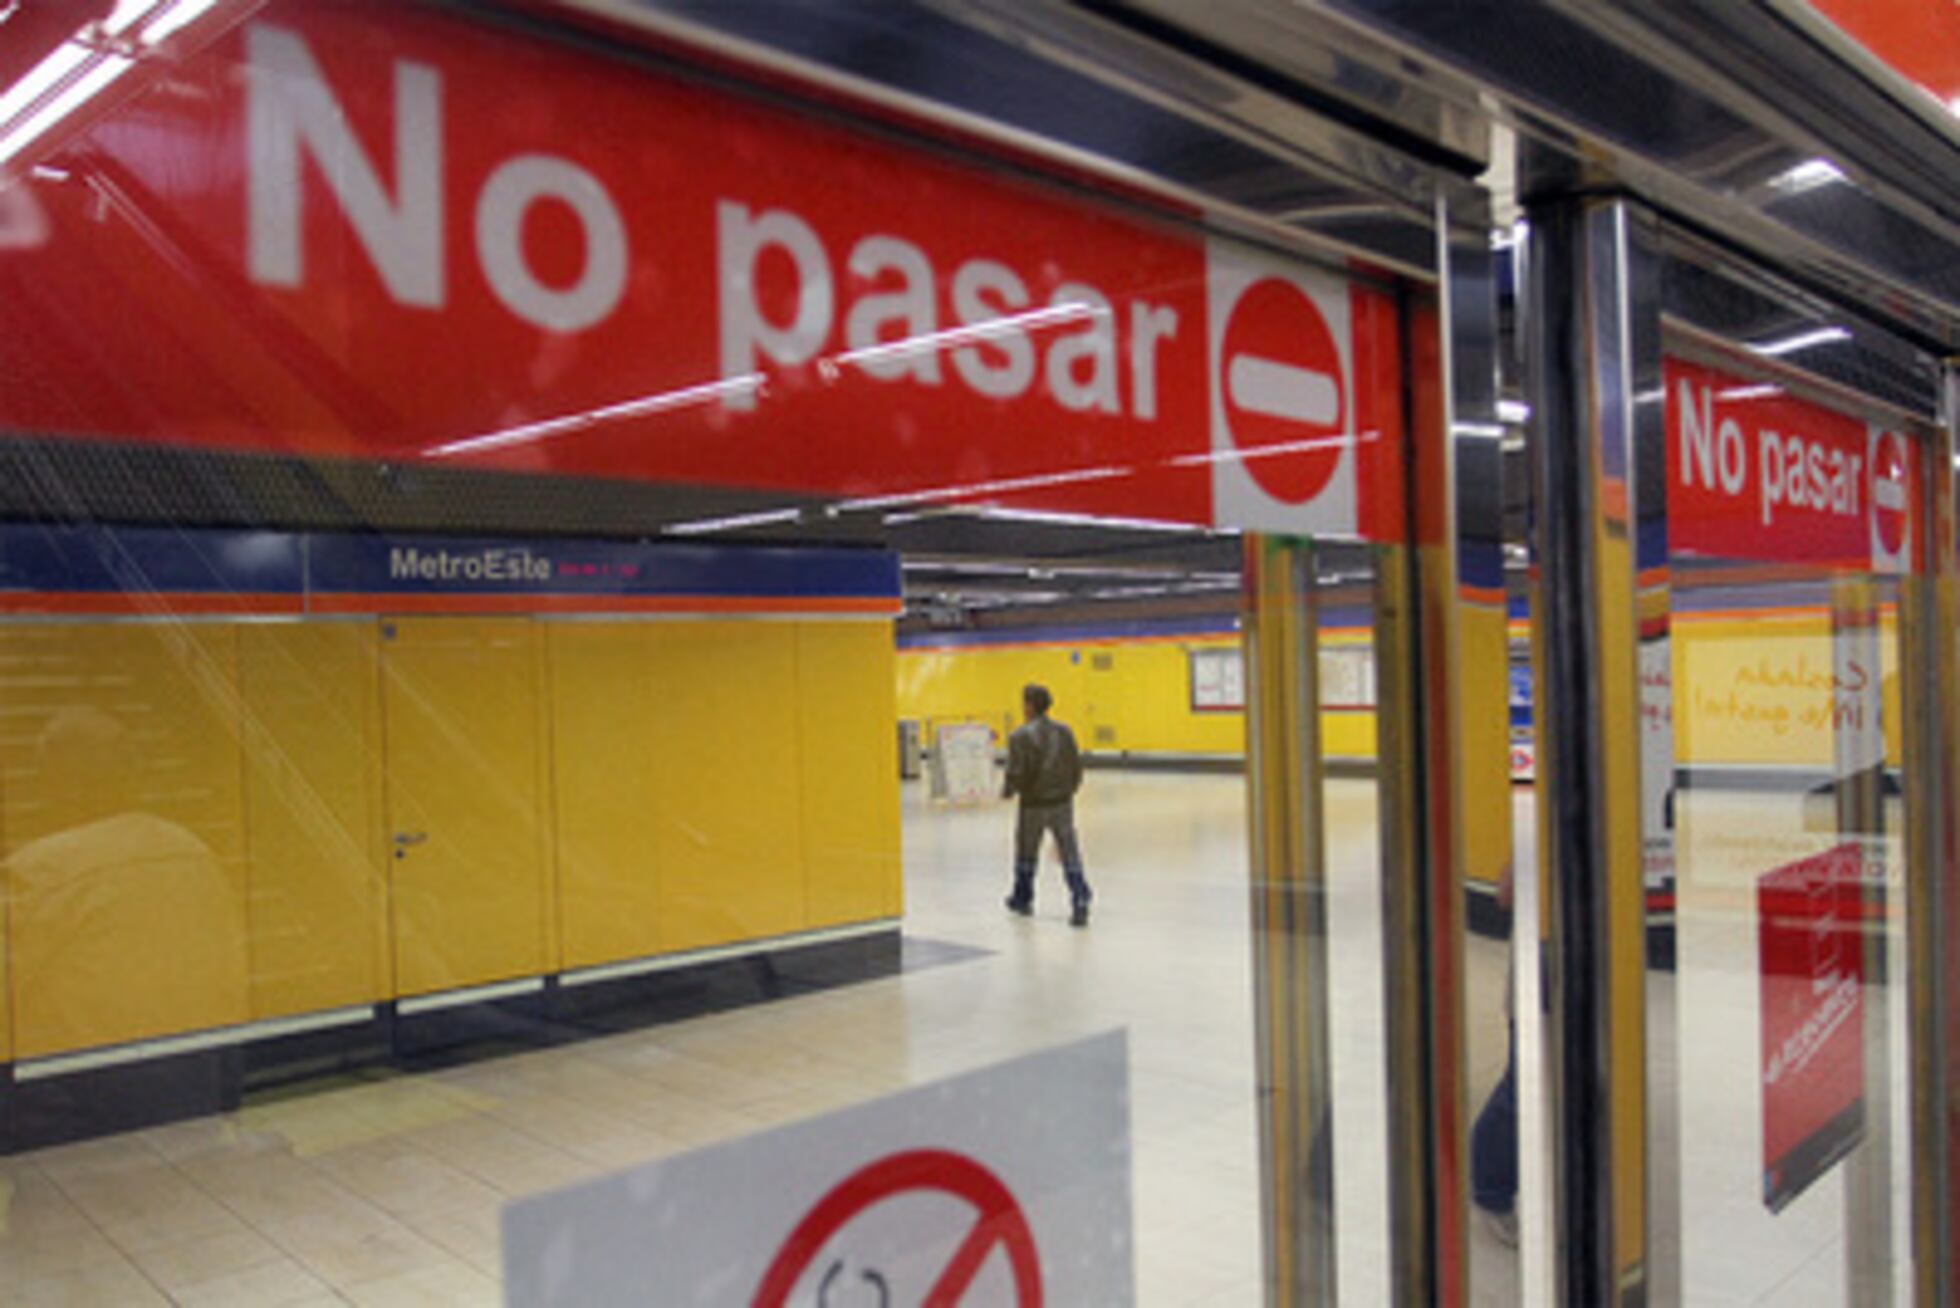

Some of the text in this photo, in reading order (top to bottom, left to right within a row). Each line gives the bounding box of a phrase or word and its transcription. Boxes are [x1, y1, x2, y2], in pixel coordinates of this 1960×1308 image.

[246, 20, 1179, 422] No pasar
[1678, 377, 1863, 527] No pasar
[389, 548, 550, 580] MetroEste
